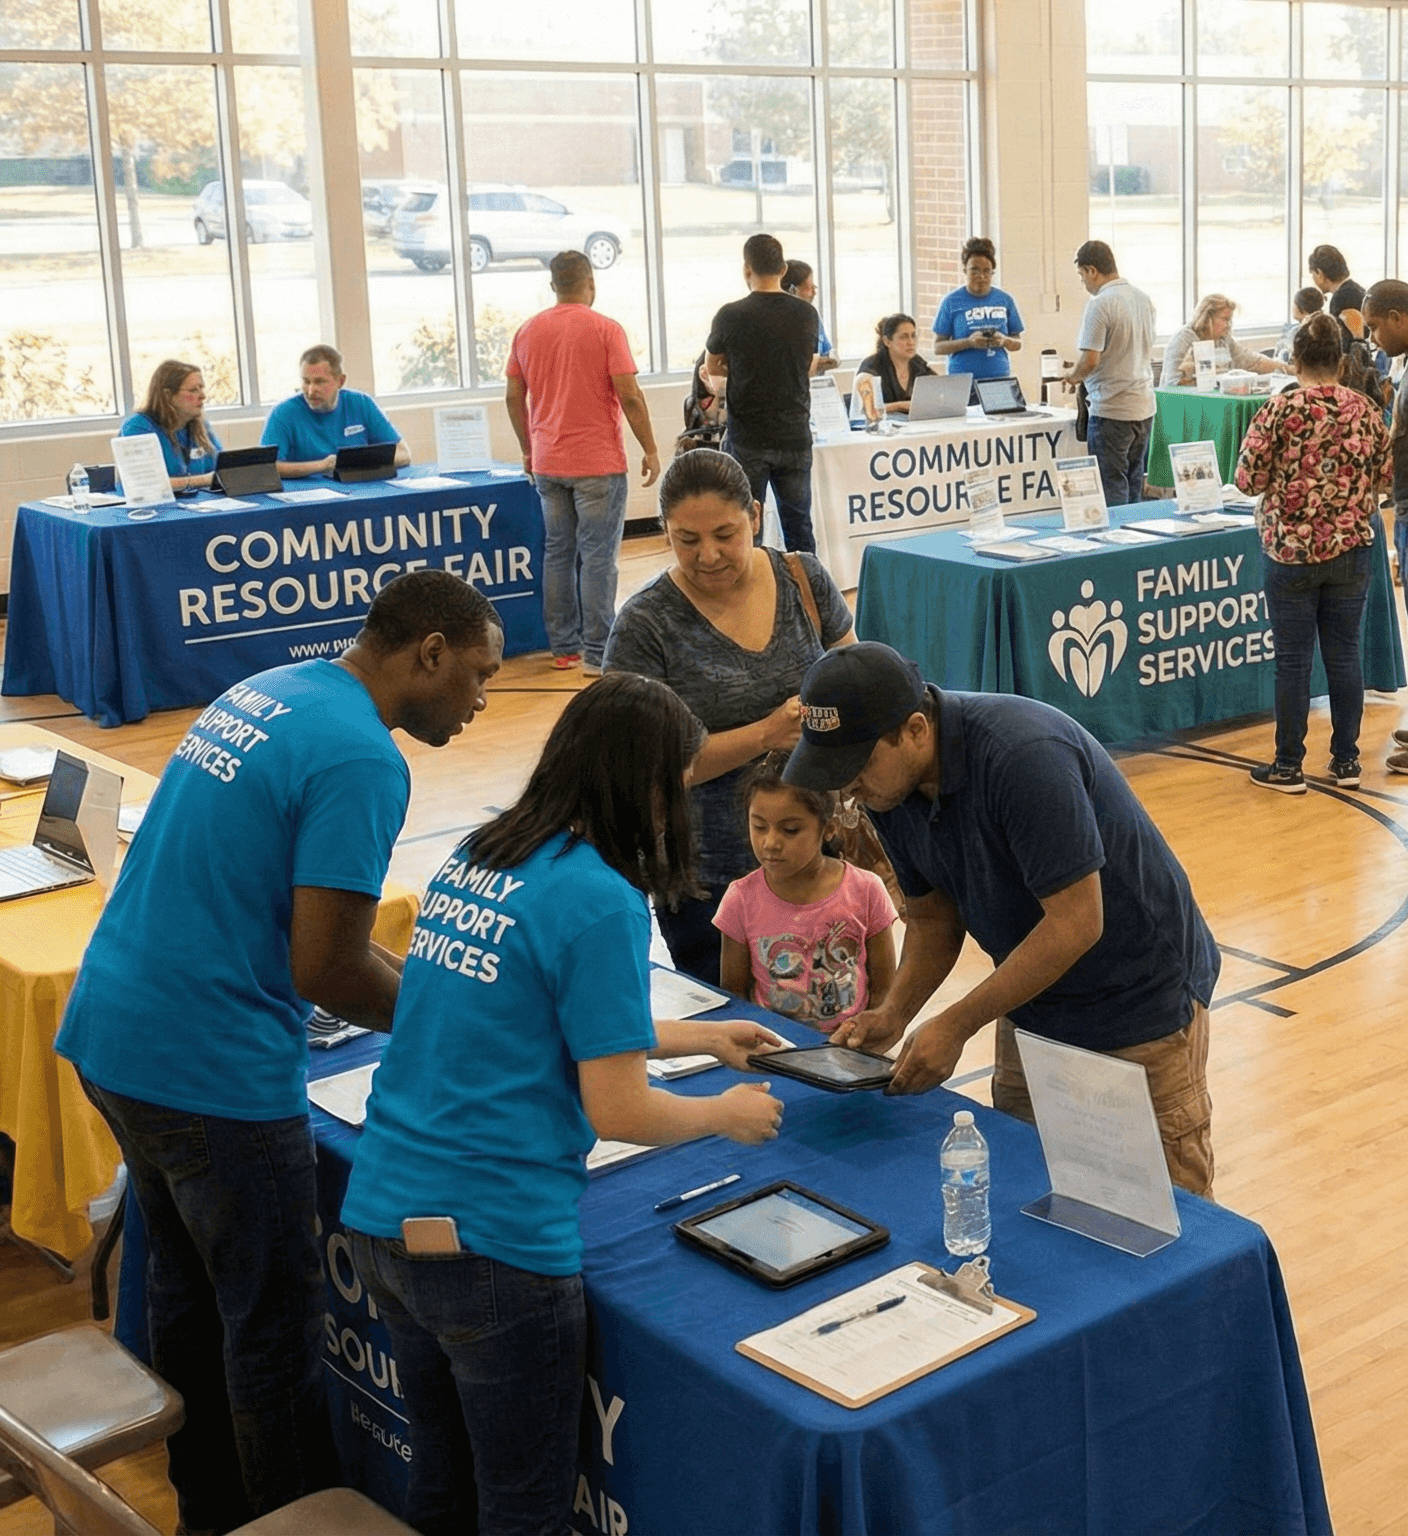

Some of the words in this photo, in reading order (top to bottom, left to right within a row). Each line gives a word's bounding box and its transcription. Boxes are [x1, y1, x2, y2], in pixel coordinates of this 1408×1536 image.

[869, 430, 1063, 481] COMMUNITY
[848, 475, 1013, 524] RESOURE
[1022, 470, 1060, 501] FA
[205, 503, 498, 573] COMMUNITY
[179, 559, 428, 627] RESOURC
[1137, 554, 1244, 602] FAMILY
[1137, 590, 1269, 645] SUPPORT
[1138, 628, 1275, 686] SERVICES
[175, 733, 243, 783] ERVICES
[434, 858, 525, 903] FAMILY
[418, 891, 516, 945] UPPORT
[408, 926, 501, 984] ERVICES
[572, 1473, 629, 1536] AIR
